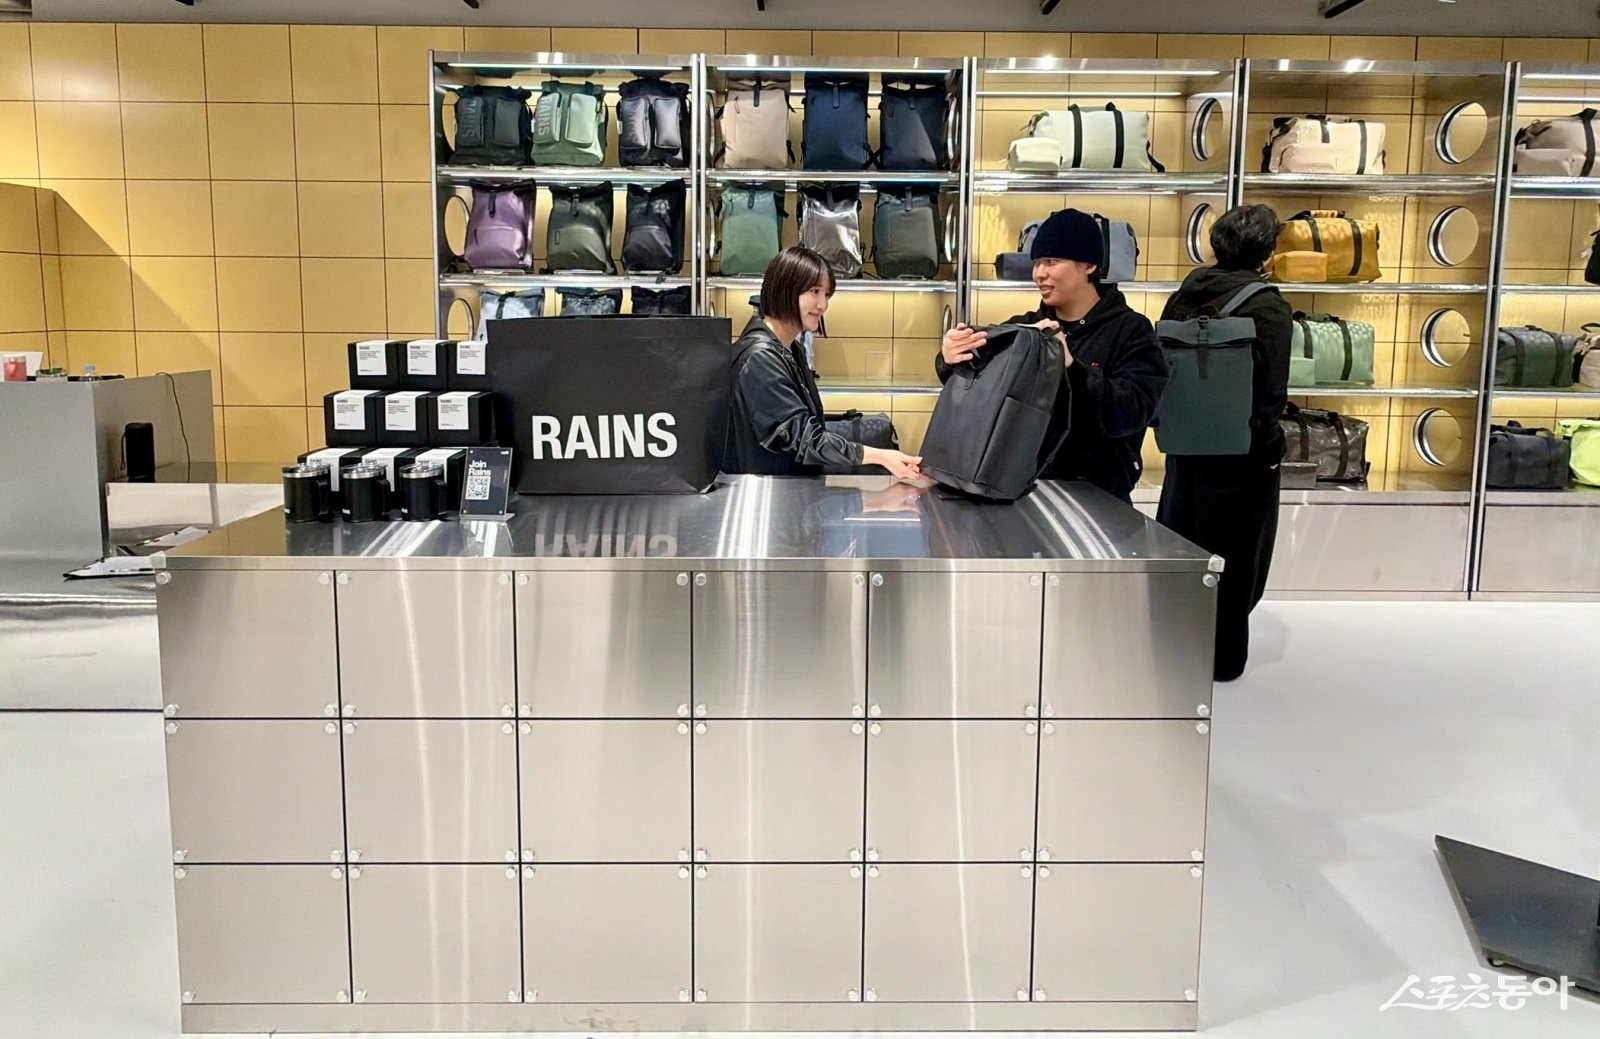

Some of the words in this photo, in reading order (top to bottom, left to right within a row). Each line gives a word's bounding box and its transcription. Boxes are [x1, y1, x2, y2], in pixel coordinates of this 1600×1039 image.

[539, 95, 553, 136] RAINS
[532, 412, 678, 460] RAINS
[468, 468, 491, 476] Rains
[469, 460, 487, 468] Join
